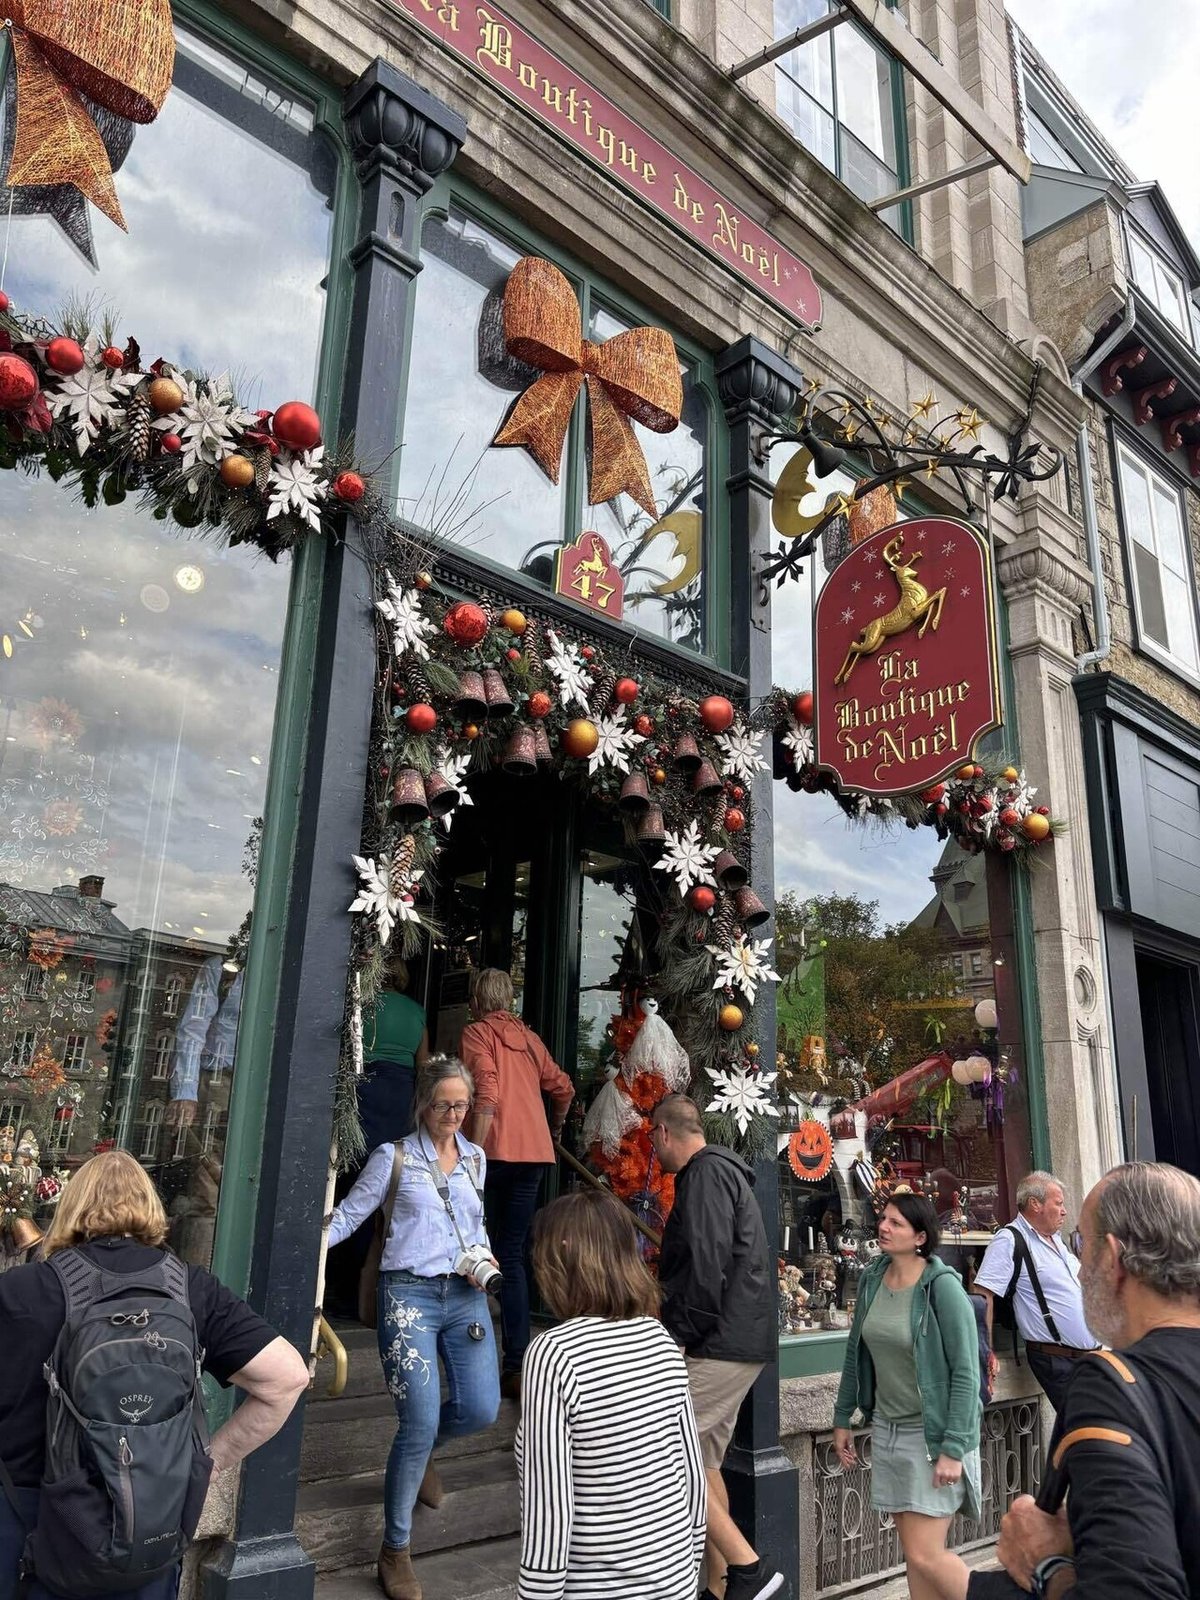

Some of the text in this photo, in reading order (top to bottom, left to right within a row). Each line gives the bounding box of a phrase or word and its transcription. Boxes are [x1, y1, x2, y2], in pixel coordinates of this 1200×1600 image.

[401, 0, 781, 287] a Boutique de Noël
[570, 574, 616, 609] 47
[877, 650, 920, 697] La
[834, 680, 970, 744] Boutique
[844, 710, 961, 782] de Noël
[119, 1393, 154, 1405] OSPREY
